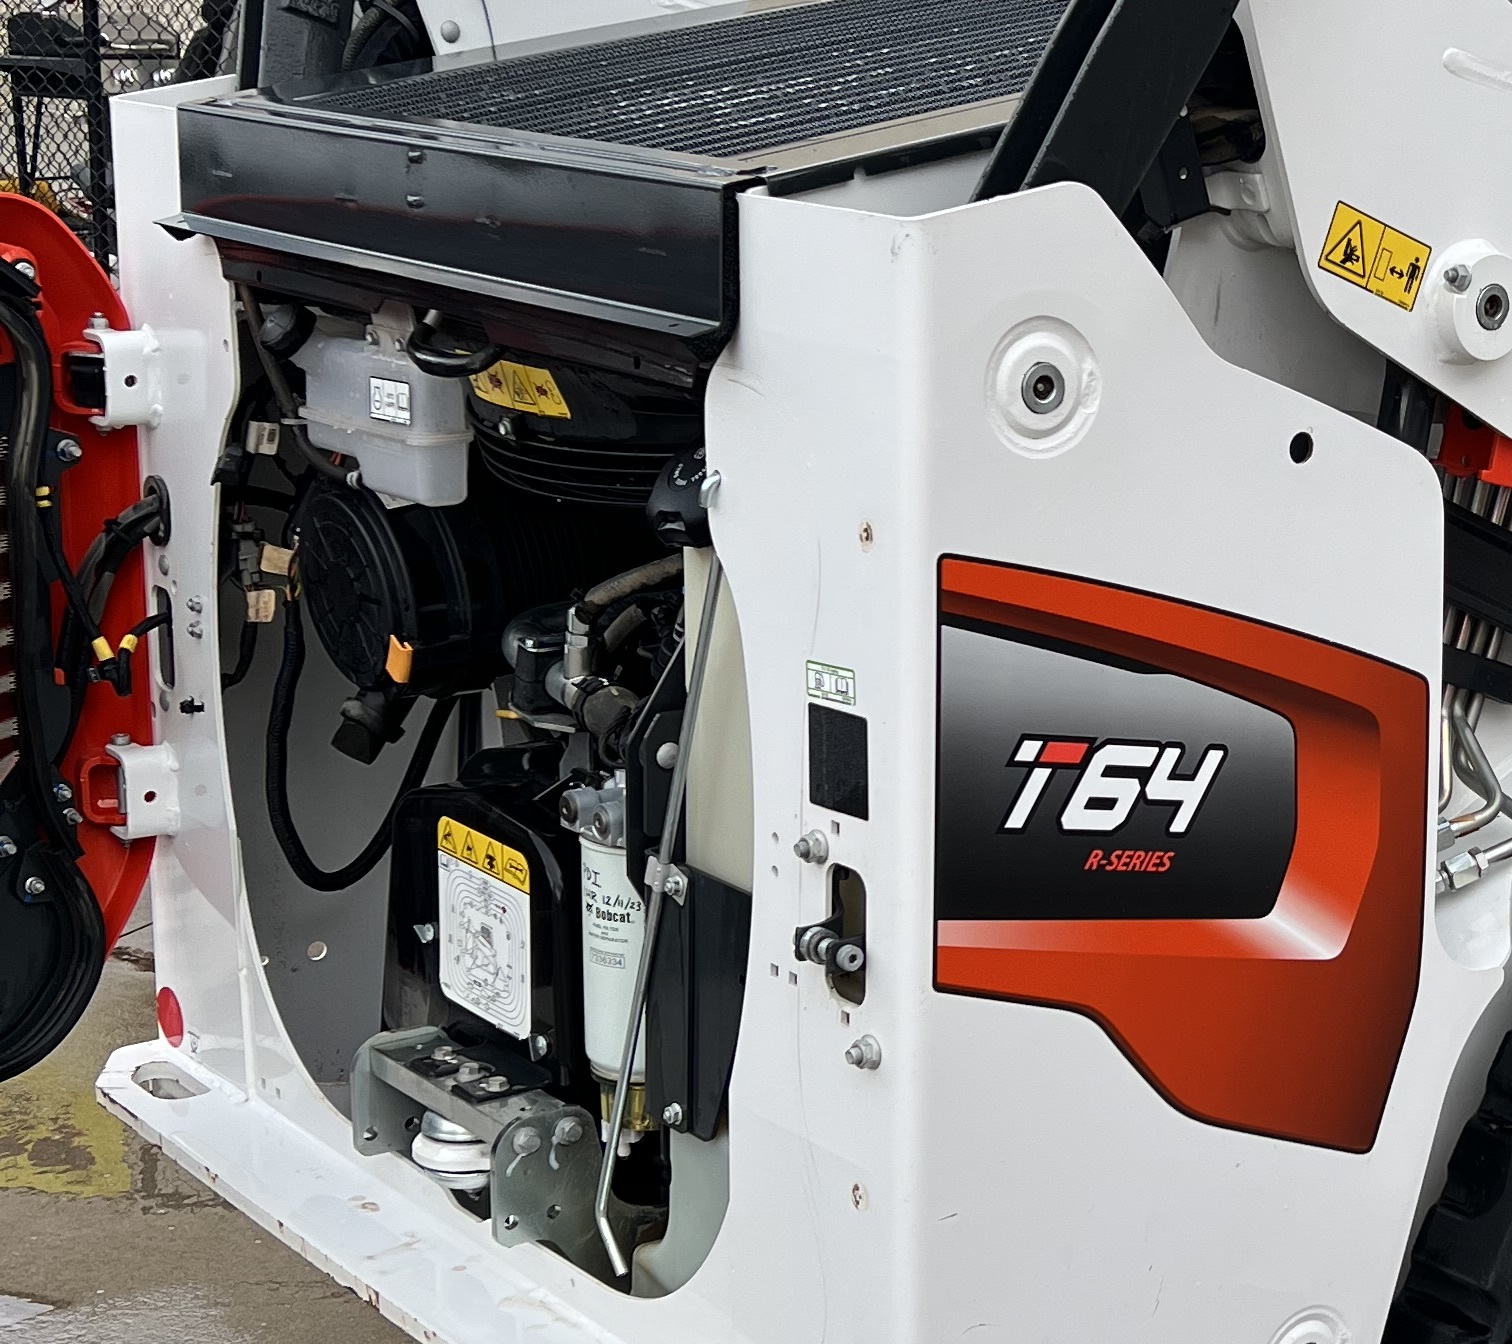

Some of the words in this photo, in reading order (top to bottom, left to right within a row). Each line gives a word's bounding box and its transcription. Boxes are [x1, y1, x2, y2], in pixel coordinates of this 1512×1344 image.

[1004, 740, 1225, 833] T64
[1084, 849, 1176, 872] R-SERIES
[596, 907, 631, 924] Bobcat
